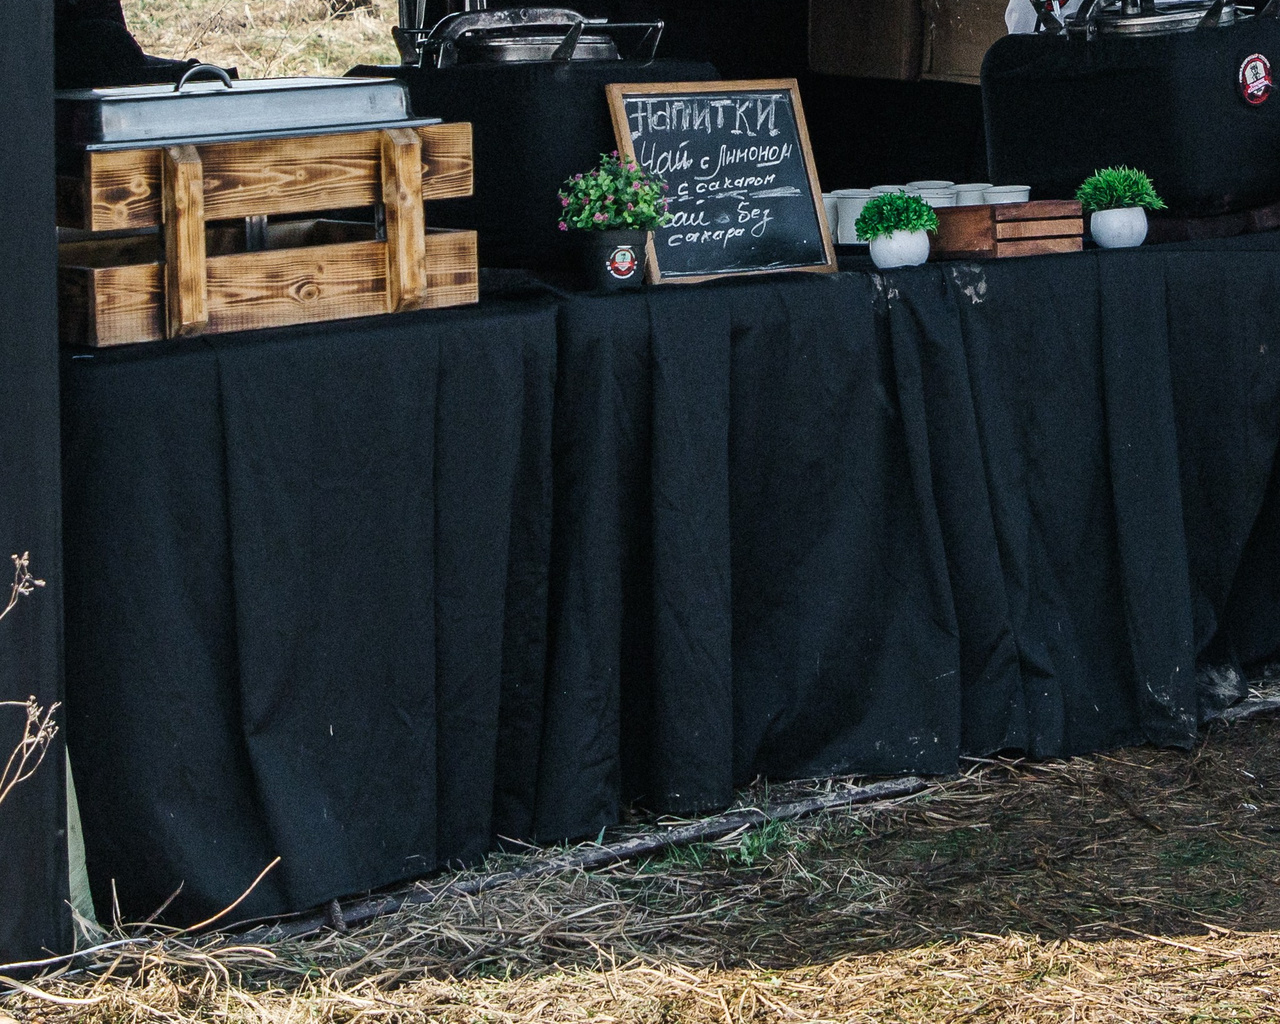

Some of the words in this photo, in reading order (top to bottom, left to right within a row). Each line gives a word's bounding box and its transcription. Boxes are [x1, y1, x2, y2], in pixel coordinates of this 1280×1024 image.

[640, 140, 694, 175] Чай
[695, 174, 776, 194] сахаром
[660, 199, 711, 229] ай
[667, 227, 746, 249] сахара
